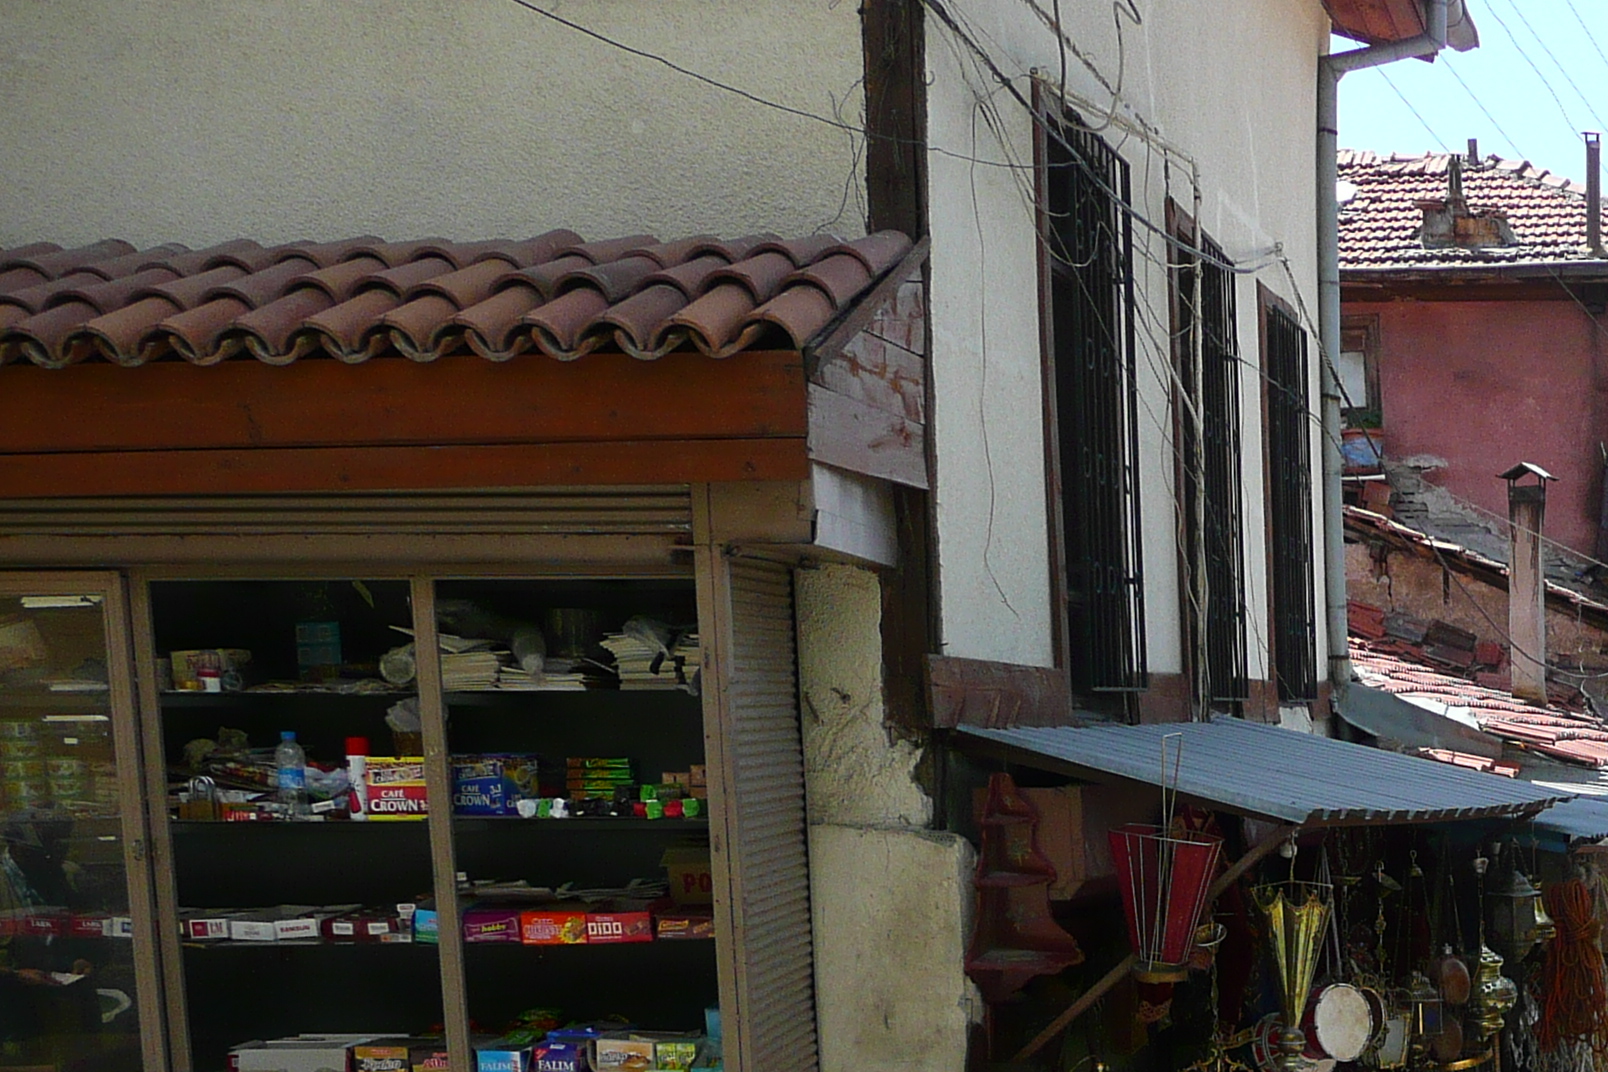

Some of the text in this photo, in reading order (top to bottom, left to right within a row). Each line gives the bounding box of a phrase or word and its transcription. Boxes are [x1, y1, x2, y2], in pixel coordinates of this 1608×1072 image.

[370, 799, 418, 812] CROWN
[454, 795, 491, 806] CROWN
[538, 1060, 574, 1071] FALIM
